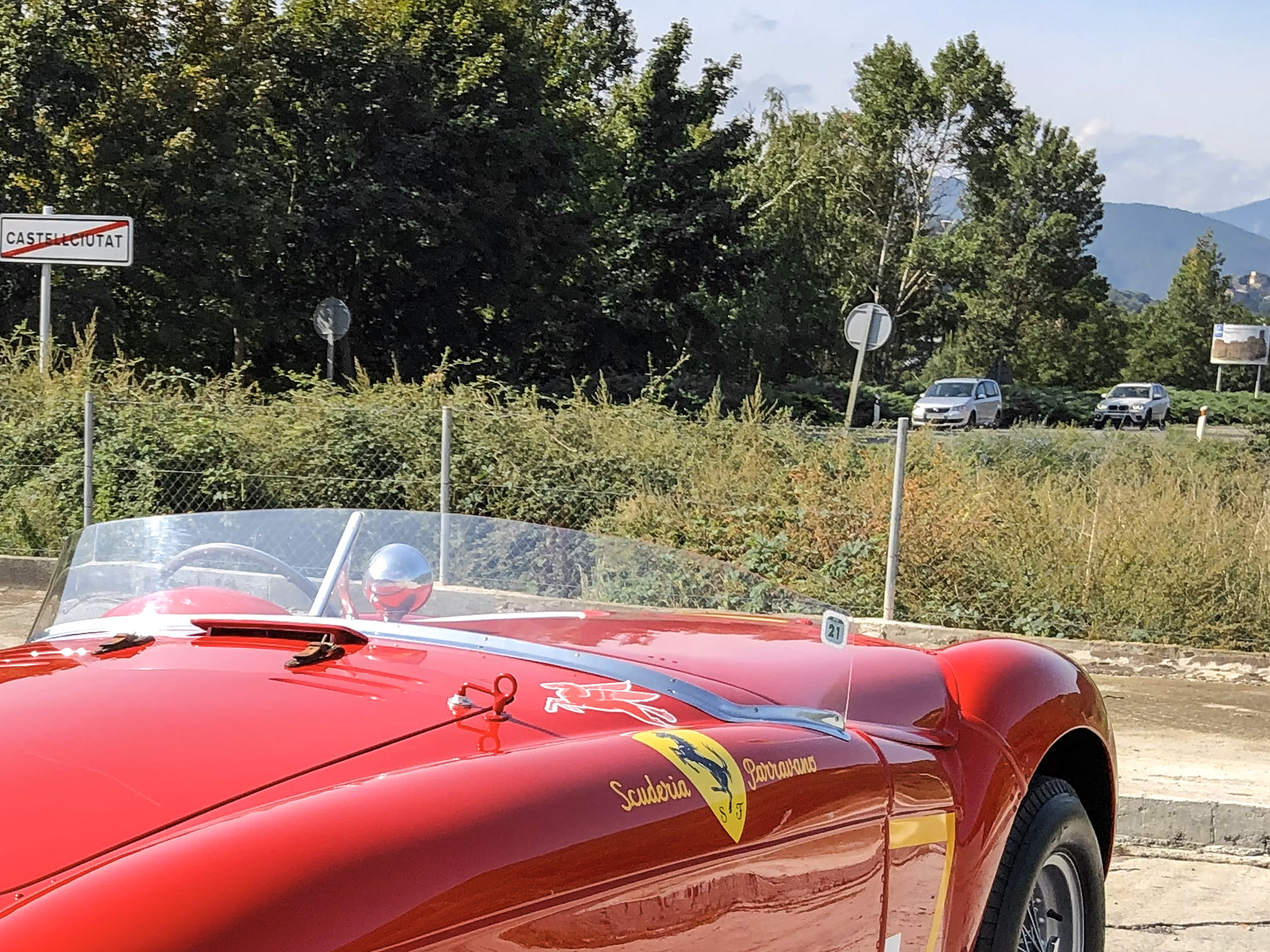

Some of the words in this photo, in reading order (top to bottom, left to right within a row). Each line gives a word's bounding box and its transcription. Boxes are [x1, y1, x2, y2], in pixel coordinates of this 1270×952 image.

[6, 231, 123, 248] CASTELLCIUTAT
[827, 623, 840, 640] 21
[609, 774, 691, 811] Scuderia
[743, 755, 817, 790] Parravano
[718, 806, 728, 823] S
